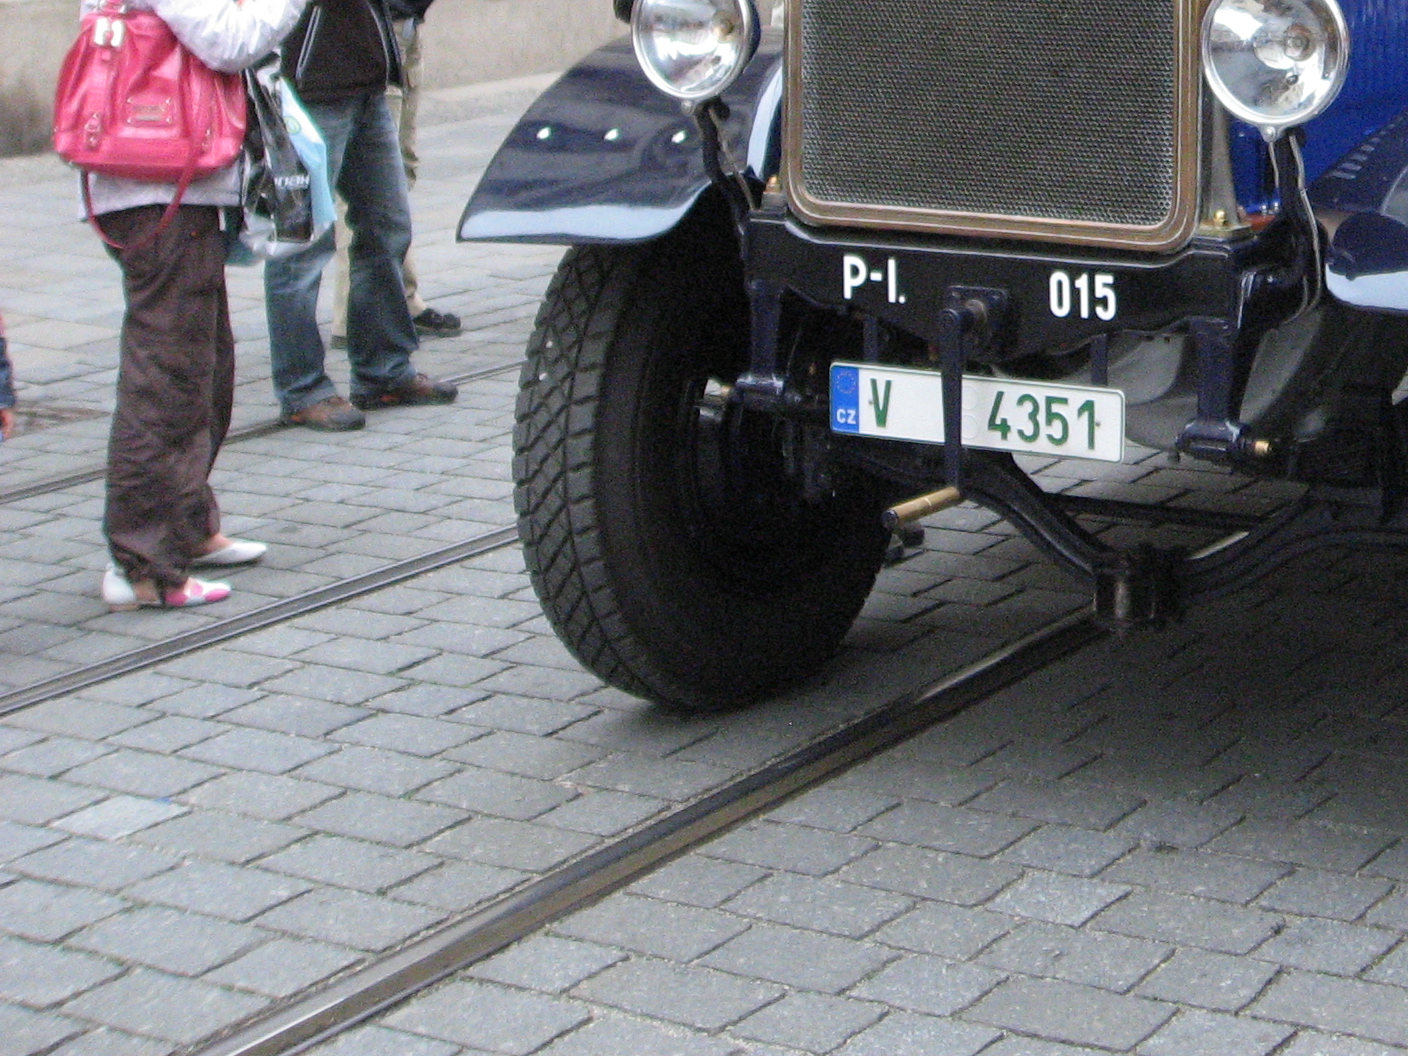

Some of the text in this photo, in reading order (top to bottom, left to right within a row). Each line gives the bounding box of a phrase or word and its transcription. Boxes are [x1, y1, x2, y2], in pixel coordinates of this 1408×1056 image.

[1049, 270, 1117, 322] 015
[836, 408, 857, 425] CZ
[869, 377, 1097, 450] V 4351
